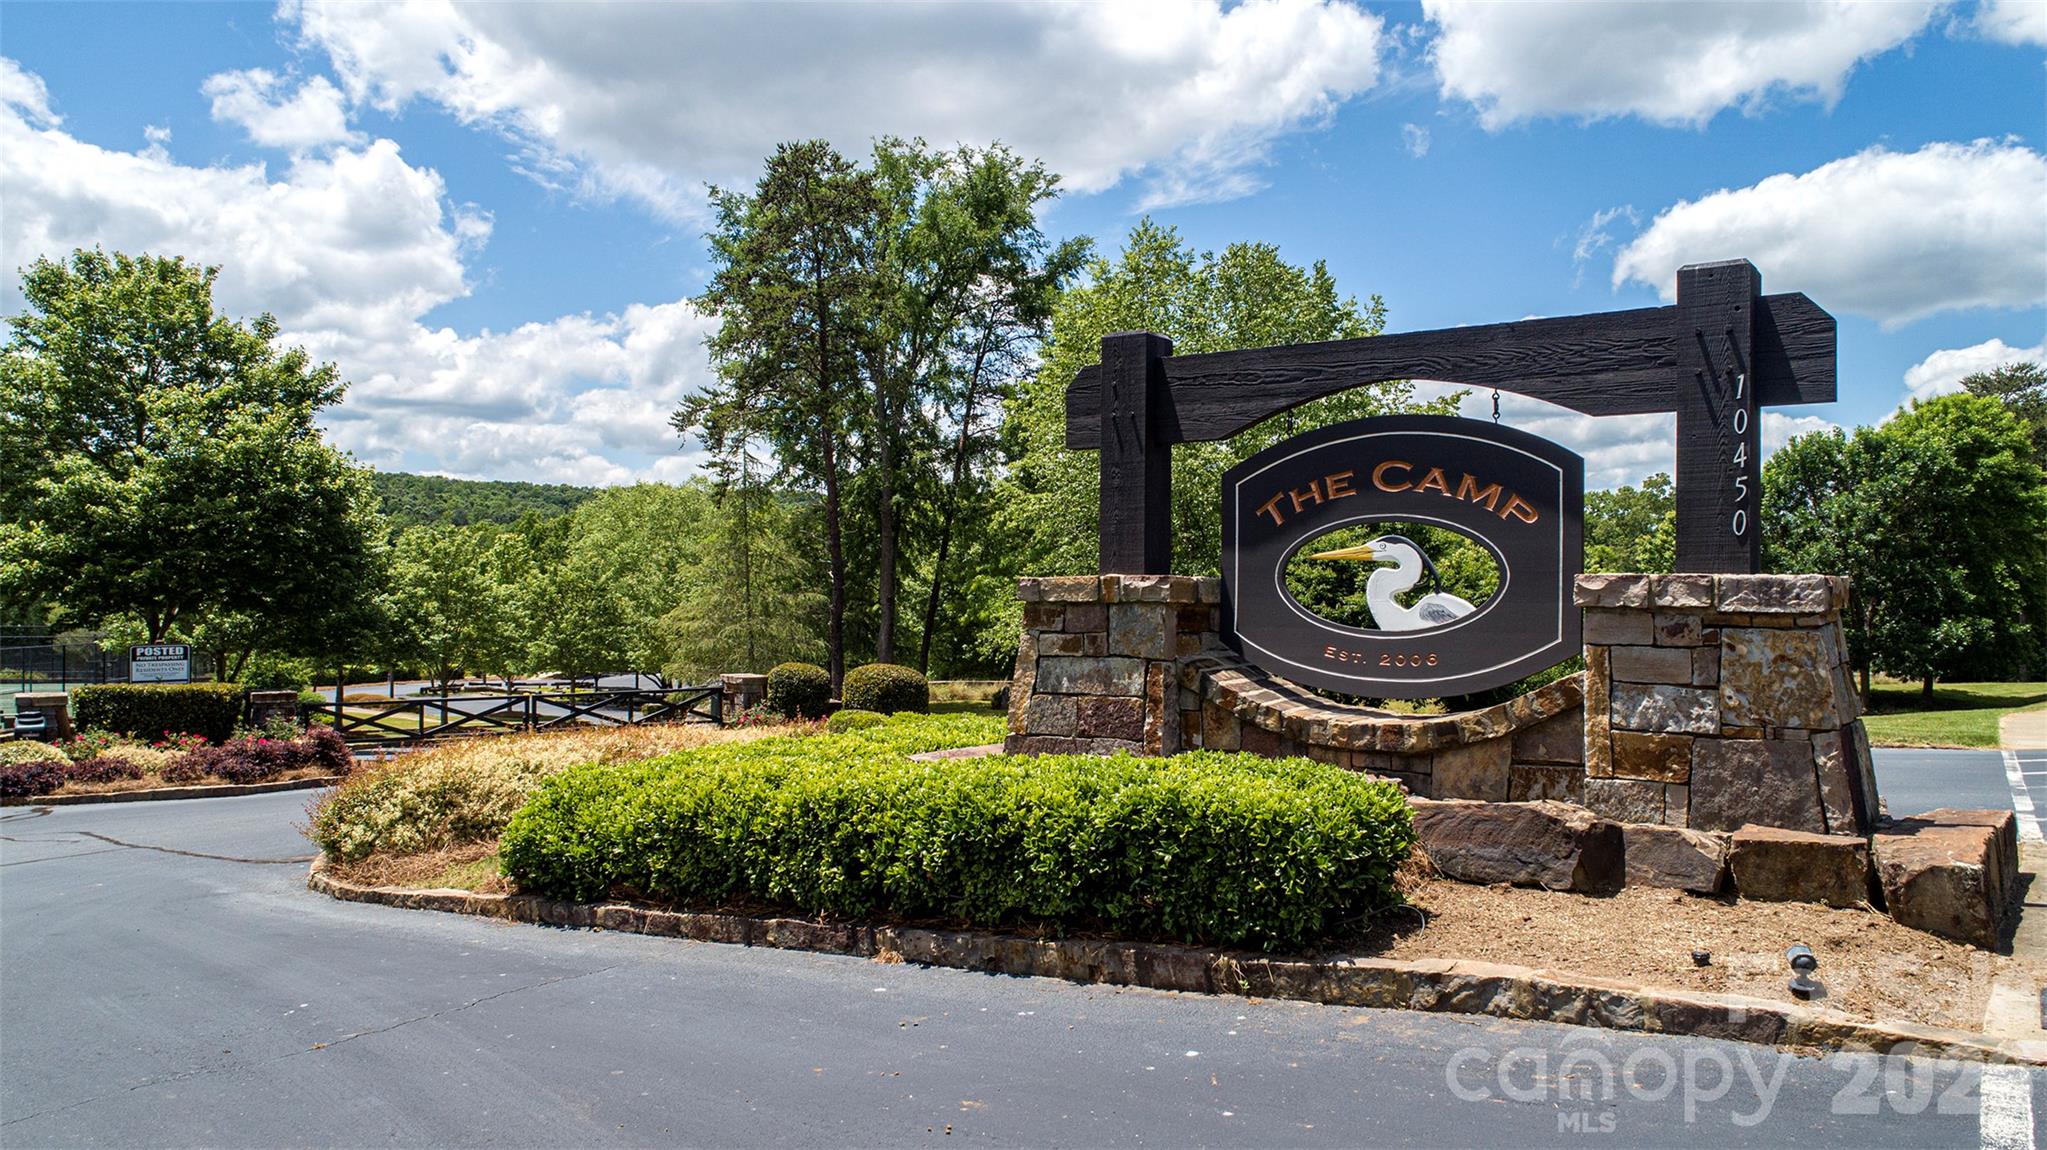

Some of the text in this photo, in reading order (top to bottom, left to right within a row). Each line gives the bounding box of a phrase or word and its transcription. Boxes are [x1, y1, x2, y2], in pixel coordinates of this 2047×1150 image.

[1732, 373, 1748, 536] 10450
[1255, 459, 1540, 528] THE CAMP
[136, 646, 184, 656] POSTED
[1323, 645, 1440, 668] EST. 2006
